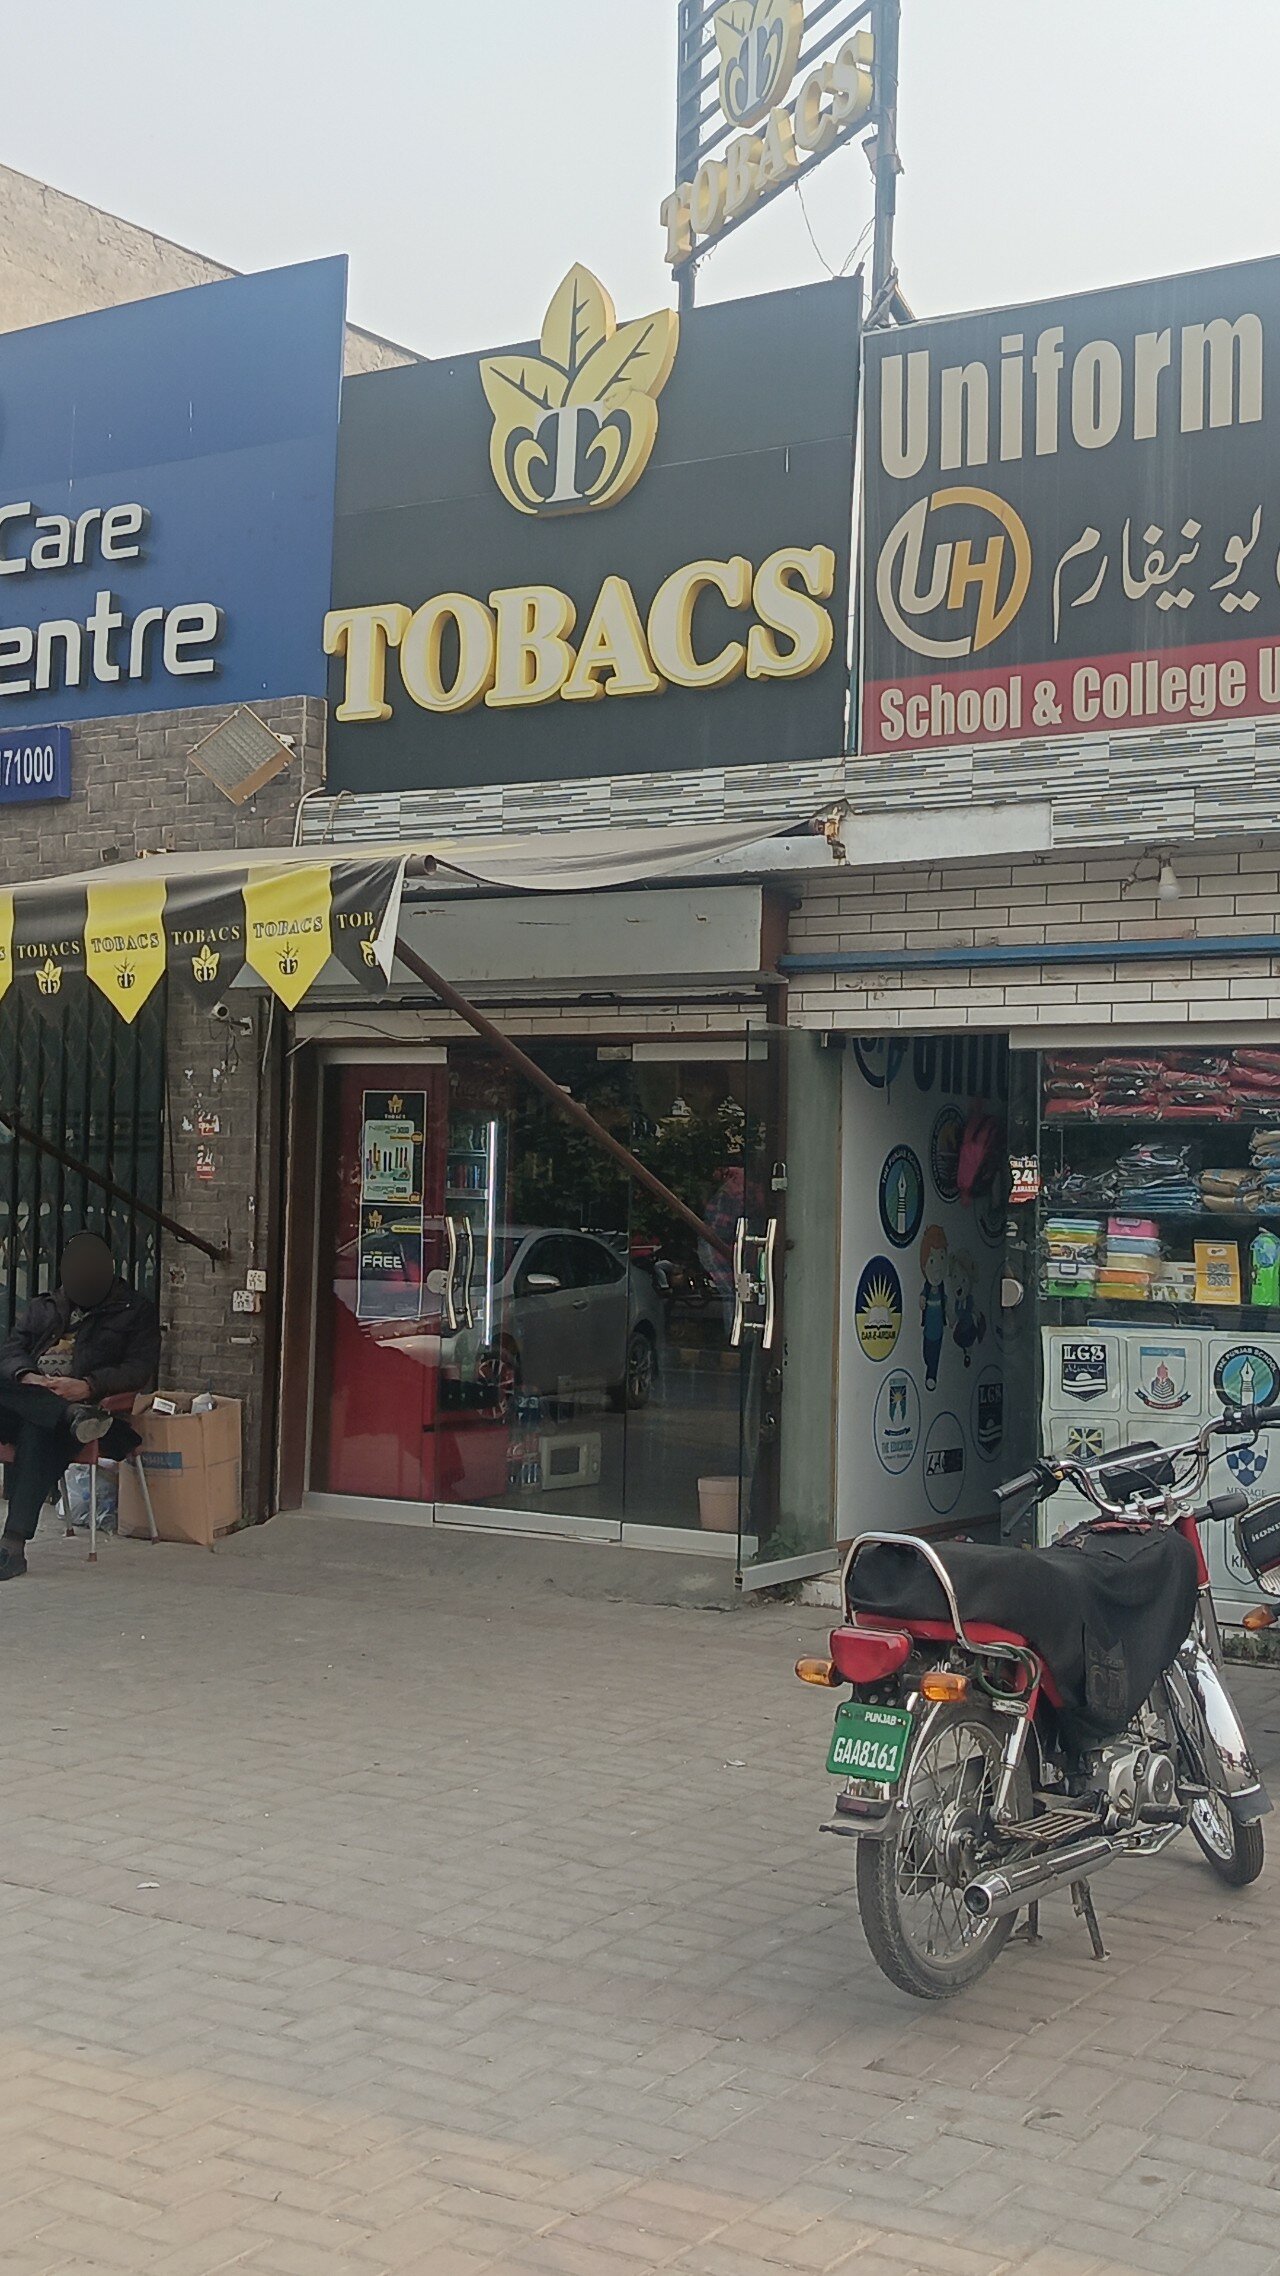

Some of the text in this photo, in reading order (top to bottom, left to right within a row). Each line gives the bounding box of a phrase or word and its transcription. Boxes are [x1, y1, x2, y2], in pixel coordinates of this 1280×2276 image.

[660, 30, 875, 263] TOBACS
[880, 313, 1263, 479] Uniform
[0, 502, 143, 575] Care
[323, 544, 836, 722] TOBACS
[880, 675, 1022, 741] School
[1032, 680, 1063, 726] &
[1073, 659, 1246, 720] College
[253, 916, 323, 938] TOBACS
[337, 911, 374, 929] TOB
[91, 933, 160, 953] TOBACS
[171, 926, 240, 945] TOBACS
[17, 941, 80, 959] TOBACS
[362, 1255, 403, 1269] FREE
[1063, 1345, 1105, 1362] LGS
[864, 1711, 897, 1726] PUNJAB
[833, 1737, 899, 1772] GAA8161
